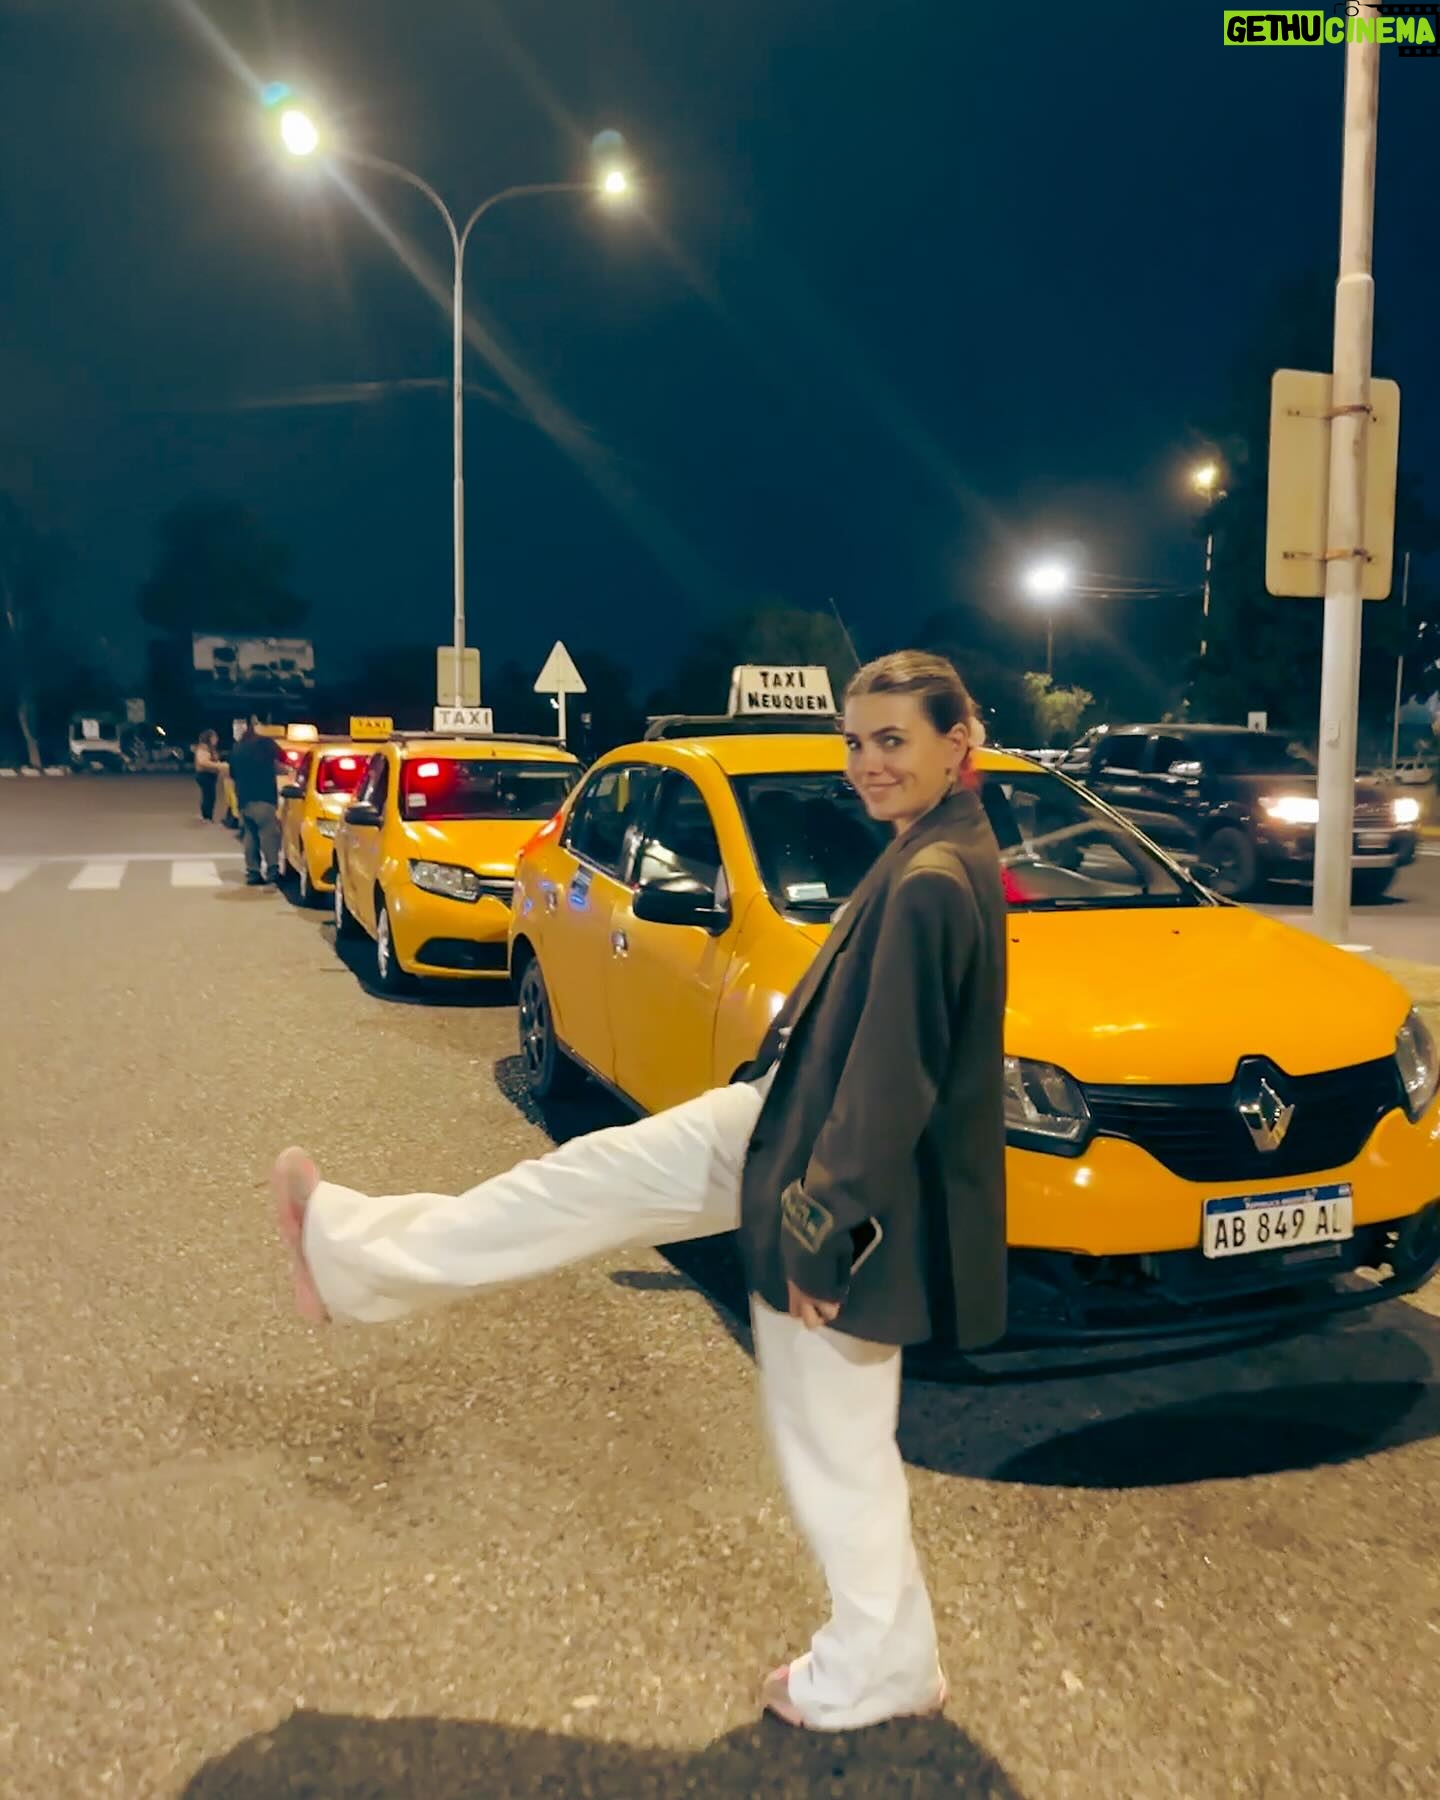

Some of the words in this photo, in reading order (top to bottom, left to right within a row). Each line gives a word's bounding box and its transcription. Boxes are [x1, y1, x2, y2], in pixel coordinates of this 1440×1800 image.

[760, 671, 805, 688] TAXI
[748, 692, 827, 710] NEUQUEN
[357, 718, 388, 729] TAXI
[439, 710, 490, 726] TAXI
[1214, 1216, 1246, 1250] AB
[1257, 1208, 1305, 1244] 849
[1315, 1203, 1342, 1235] AL
